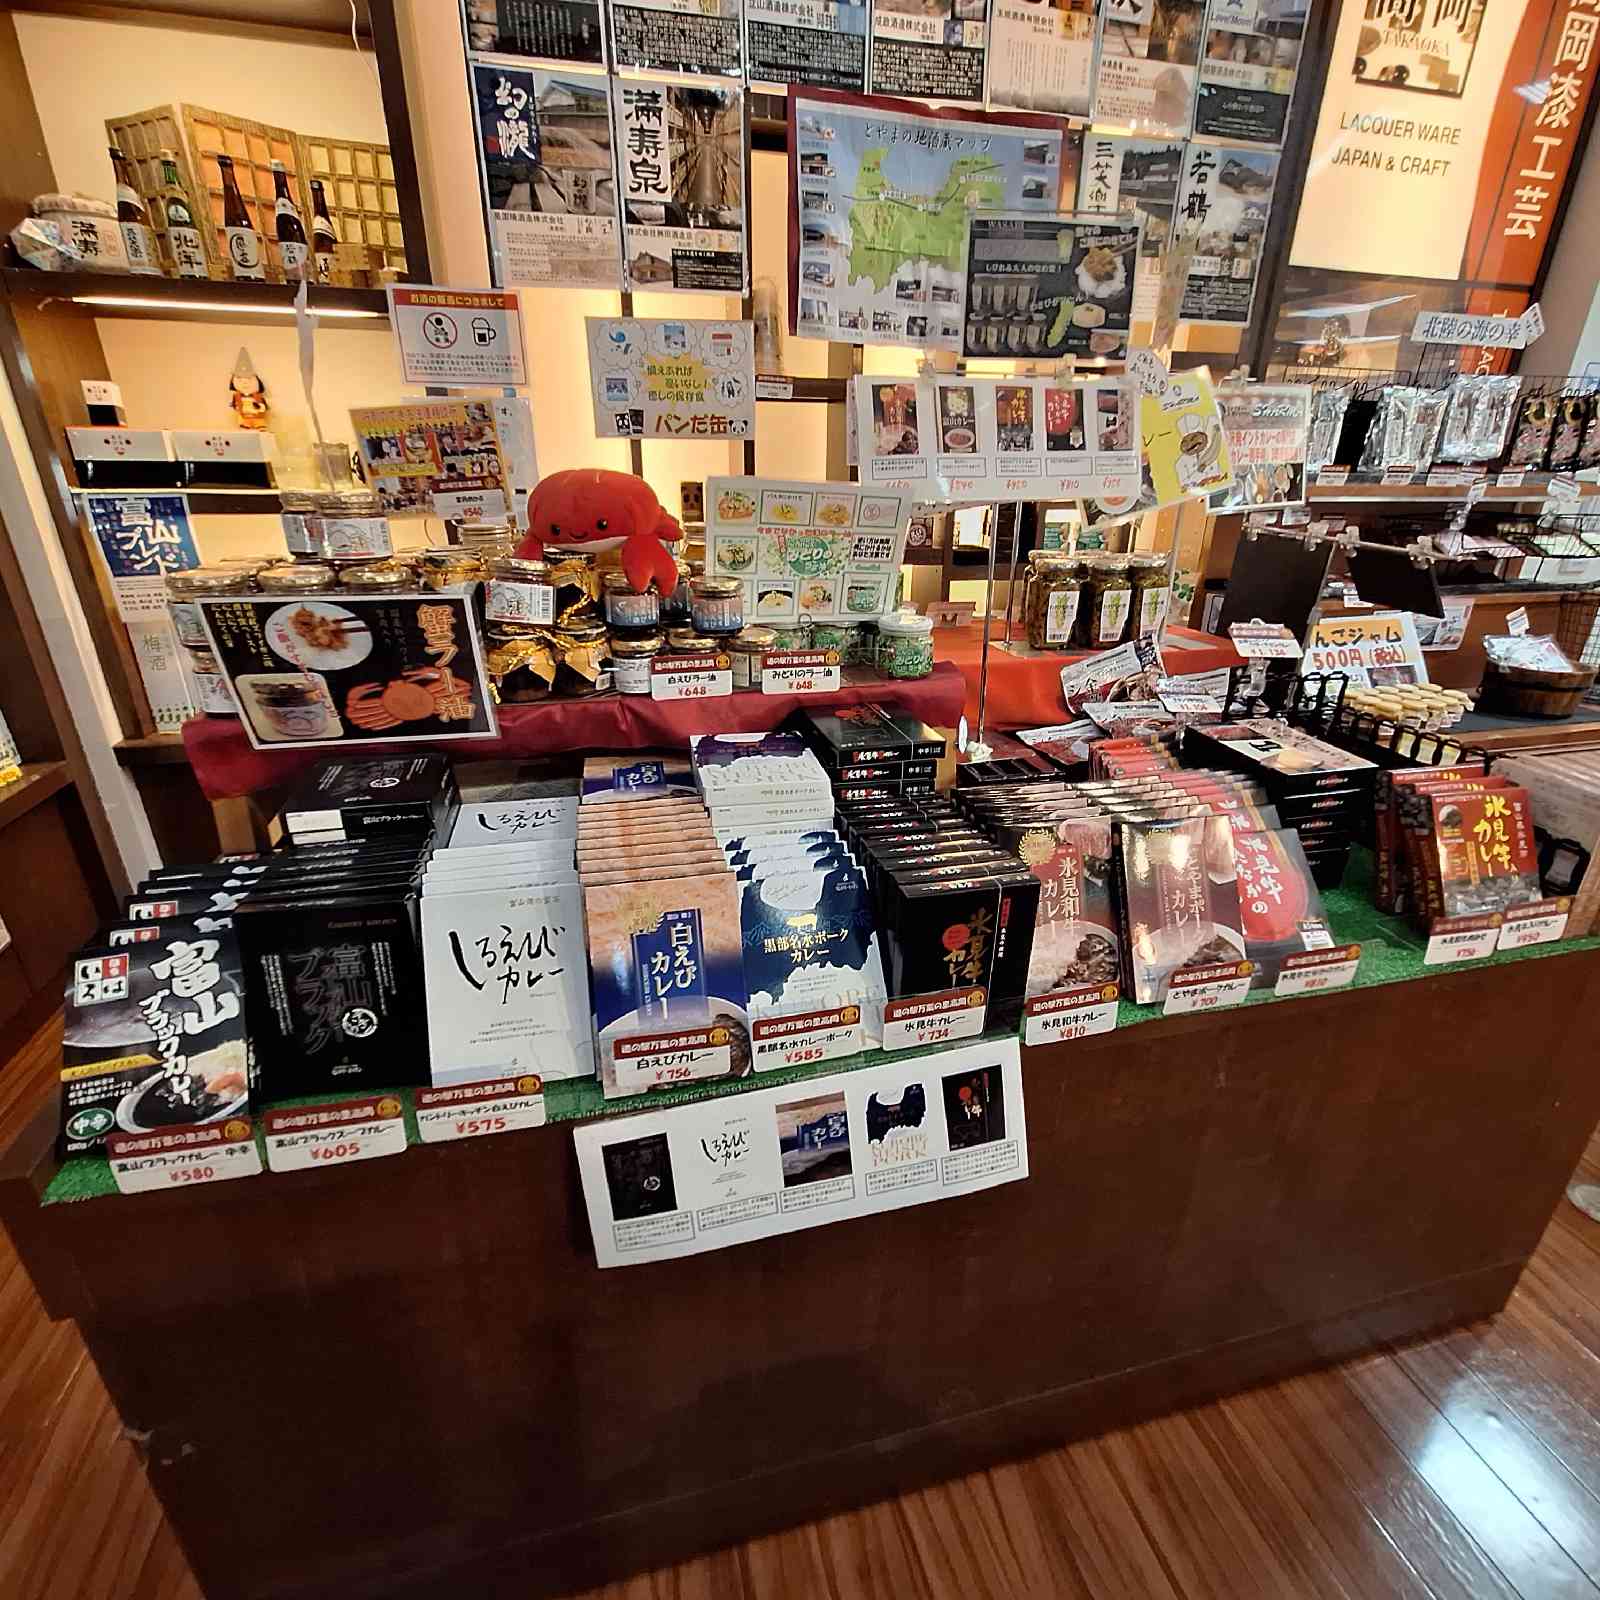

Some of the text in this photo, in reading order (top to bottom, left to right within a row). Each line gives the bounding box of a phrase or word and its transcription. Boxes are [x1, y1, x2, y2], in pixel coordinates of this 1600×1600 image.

[1340, 111, 1462, 146] LACQUER WARE
[622, 88, 669, 195] 満寿泉
[1331, 146, 1452, 177] JAPAN & CRAFT
[1422, 316, 1521, 345] 北陸の海の幸
[655, 414, 728, 435] パンだ缶
[1311, 648, 1364, 670] 500円
[667, 673, 717, 685] 白えびラー油
[771, 668, 832, 679] みどりのラー油
[678, 686, 707, 697] ¥648
[788, 679, 813, 690] ¥648
[763, 928, 850, 954] 黒部名水ポーク
[449, 924, 566, 991] しろえび
[670, 922, 698, 989] 白えび
[790, 948, 831, 964] カレー
[150, 939, 240, 1036] 富山
[496, 965, 565, 1005] カレー
[650, 951, 673, 1021] カレー
[904, 1014, 966, 1033] 氷見牛カレー
[1041, 1011, 1107, 1030] 氷見和牛カレー
[757, 1029, 854, 1054] 黒部名水カレーポーク
[636, 1050, 714, 1070] 白えびカレー
[784, 1048, 824, 1064] ¥585
[655, 1068, 691, 1081] ¥756
[455, 1116, 506, 1134] ¥575
[310, 1143, 360, 1161] ¥605
[169, 1166, 215, 1182] ¥580
